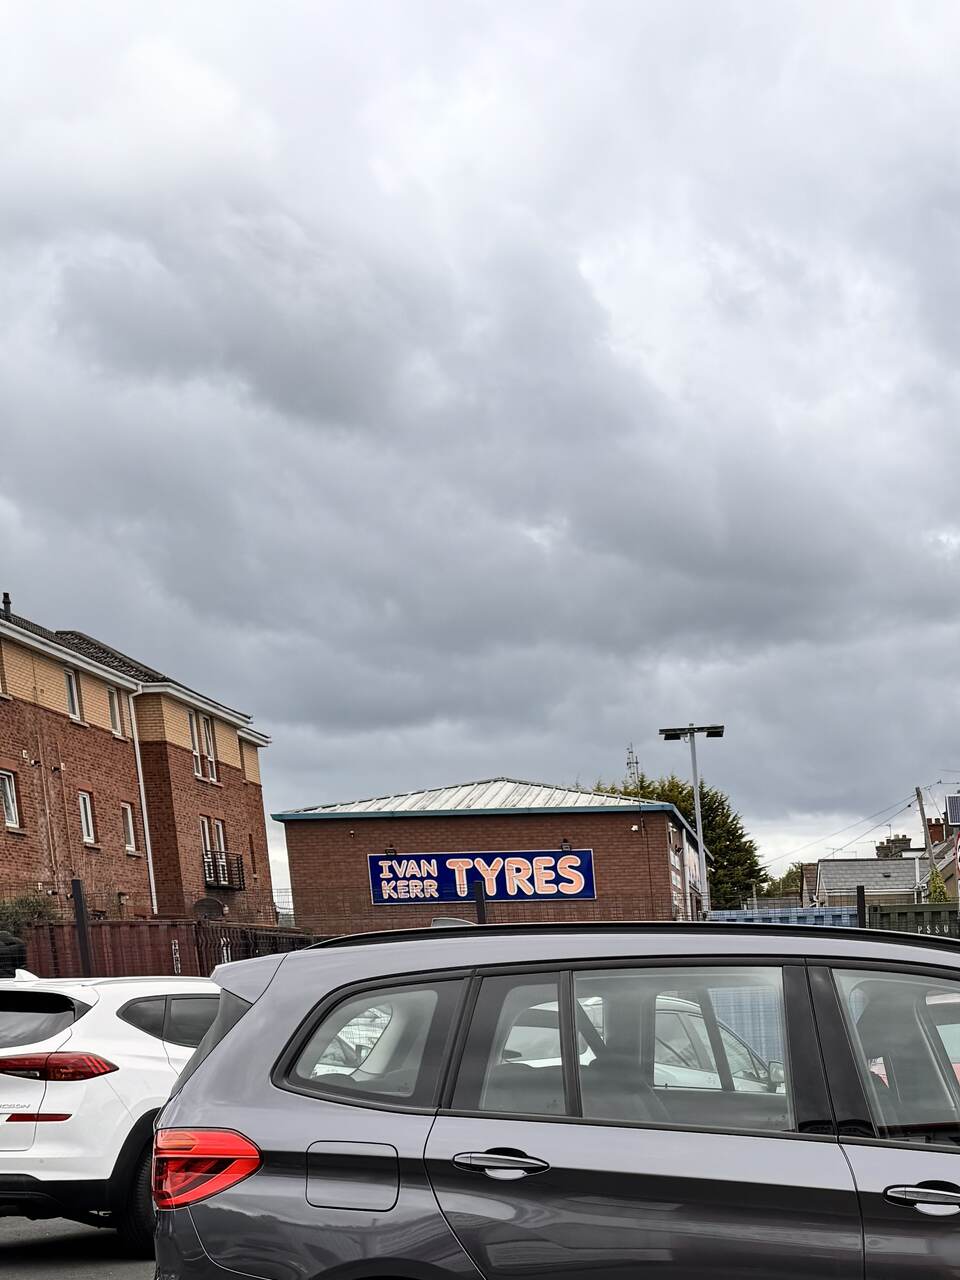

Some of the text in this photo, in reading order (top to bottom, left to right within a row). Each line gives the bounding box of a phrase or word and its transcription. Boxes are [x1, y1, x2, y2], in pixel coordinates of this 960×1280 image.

[378, 859, 439, 879] IVAN
[446, 855, 585, 897] TYRES
[381, 879, 440, 899] KERR
